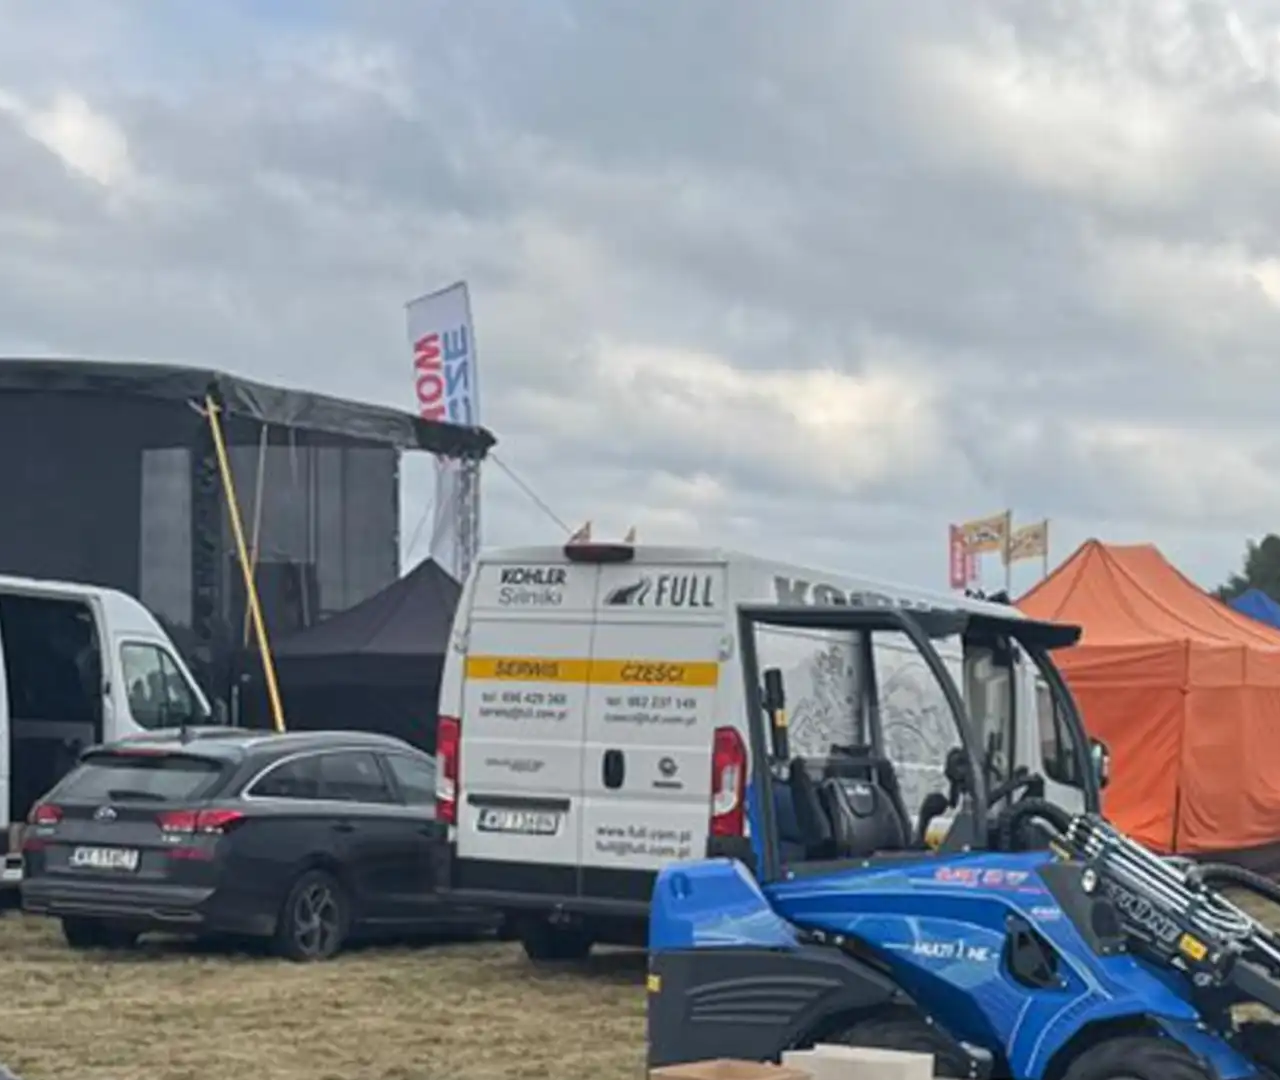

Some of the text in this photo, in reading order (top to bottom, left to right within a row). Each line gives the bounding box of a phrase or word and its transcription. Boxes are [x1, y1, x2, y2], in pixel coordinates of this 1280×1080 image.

[500, 568, 567, 585] KOHLER
[655, 576, 715, 607] FULL
[495, 660, 560, 678] SERWIS
